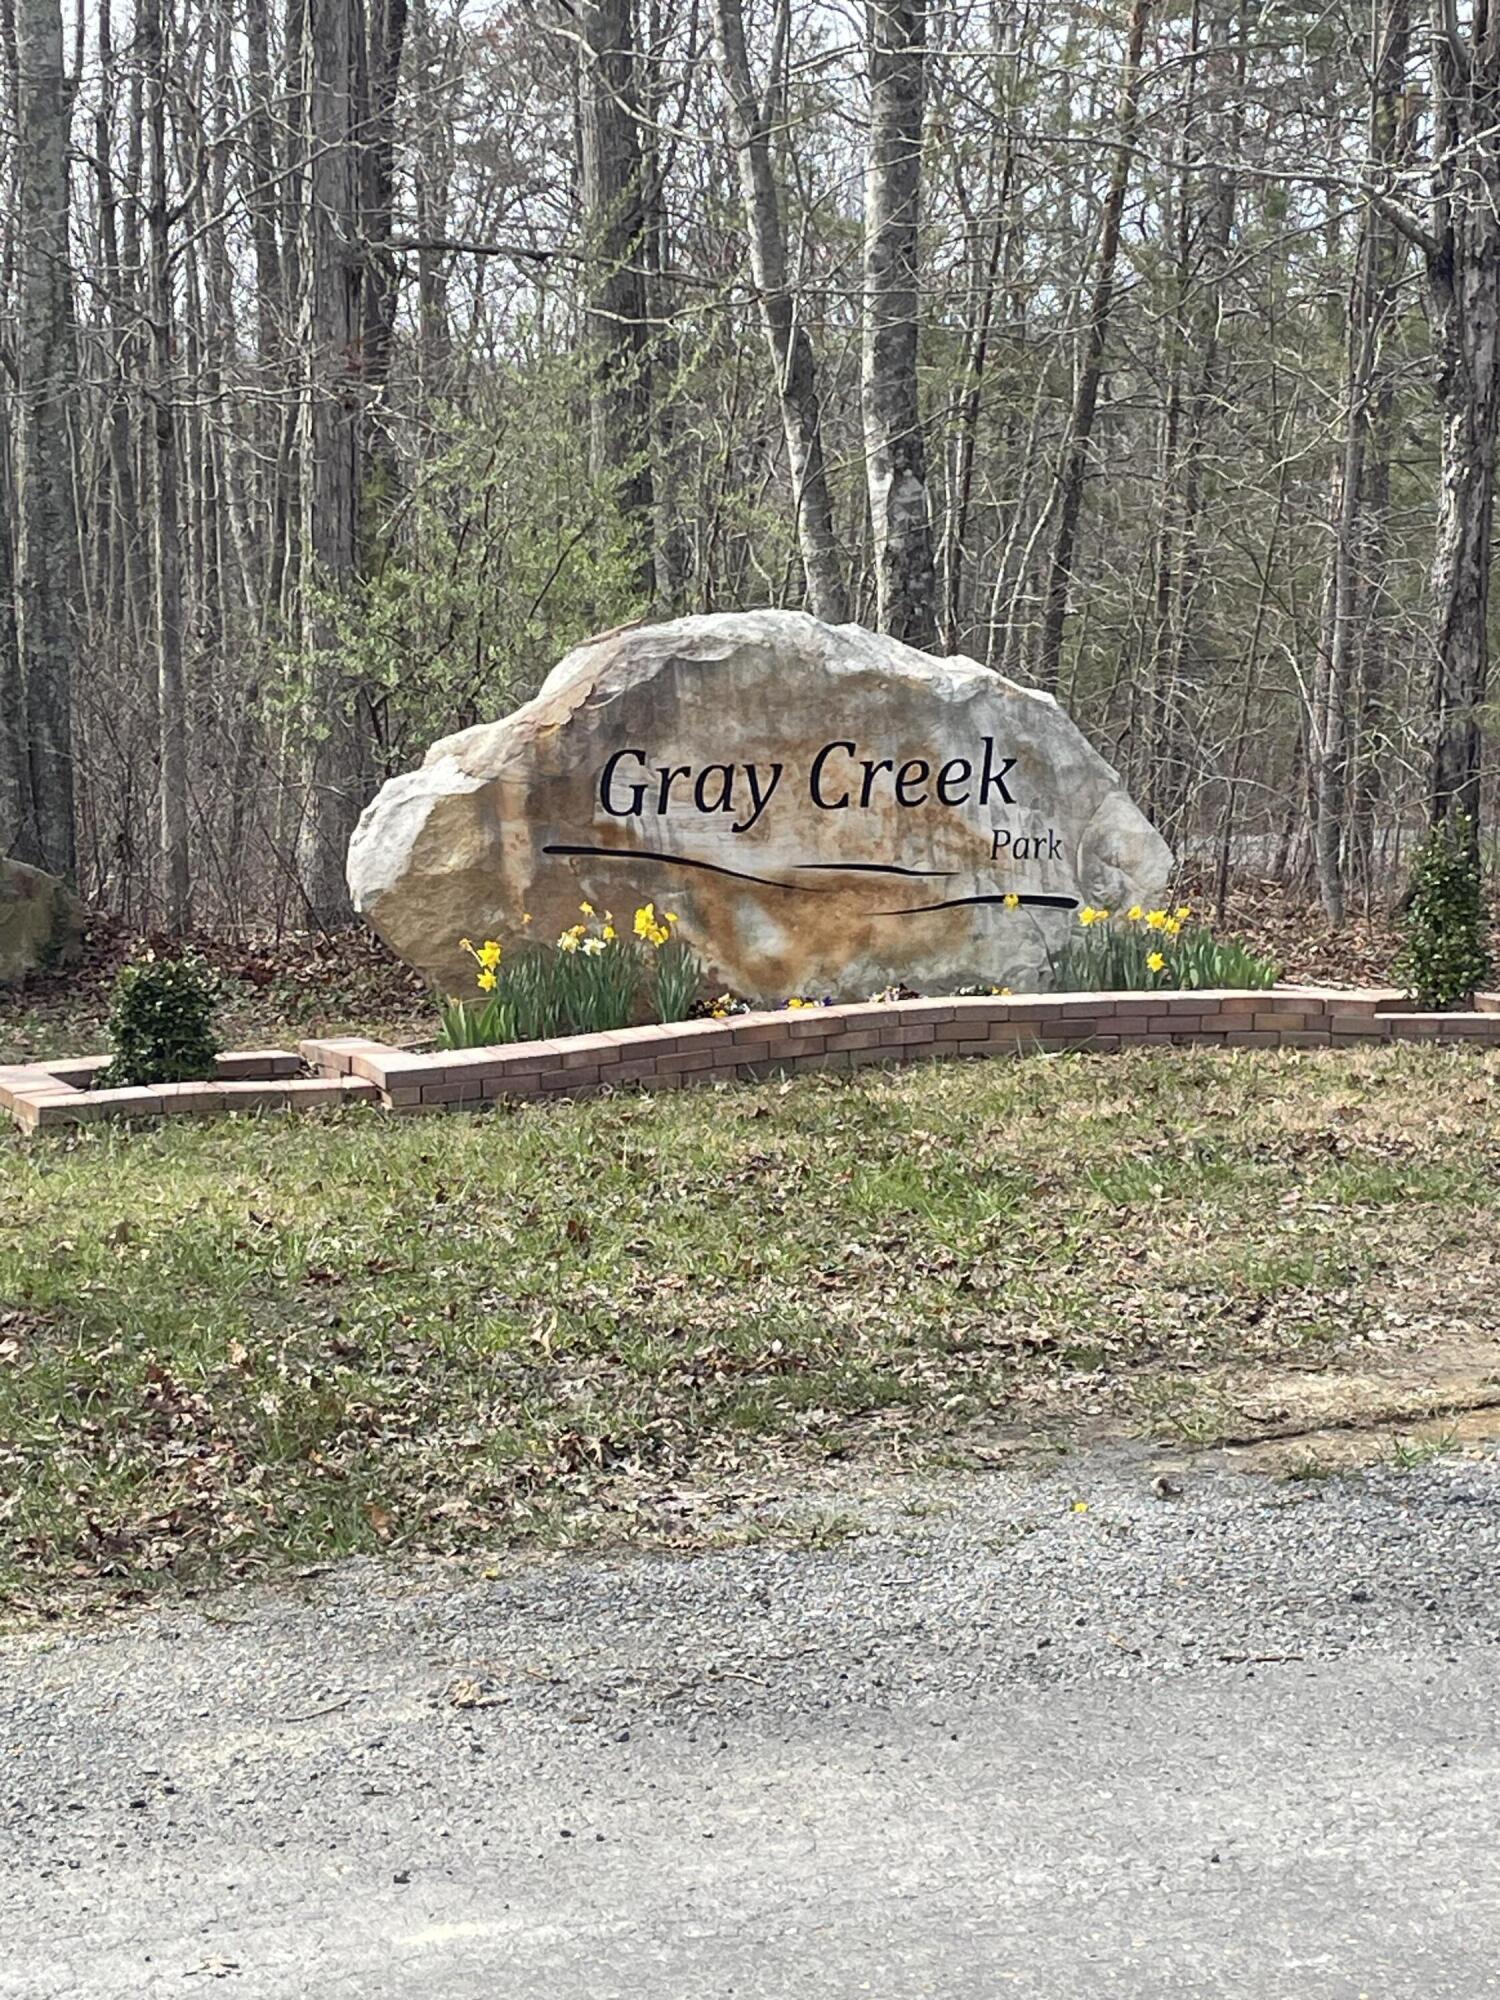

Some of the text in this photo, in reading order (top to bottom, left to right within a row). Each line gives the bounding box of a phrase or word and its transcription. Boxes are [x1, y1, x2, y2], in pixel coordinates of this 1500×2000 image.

[599, 736, 1018, 832] Gray Creek
[990, 829, 1063, 861] Park
